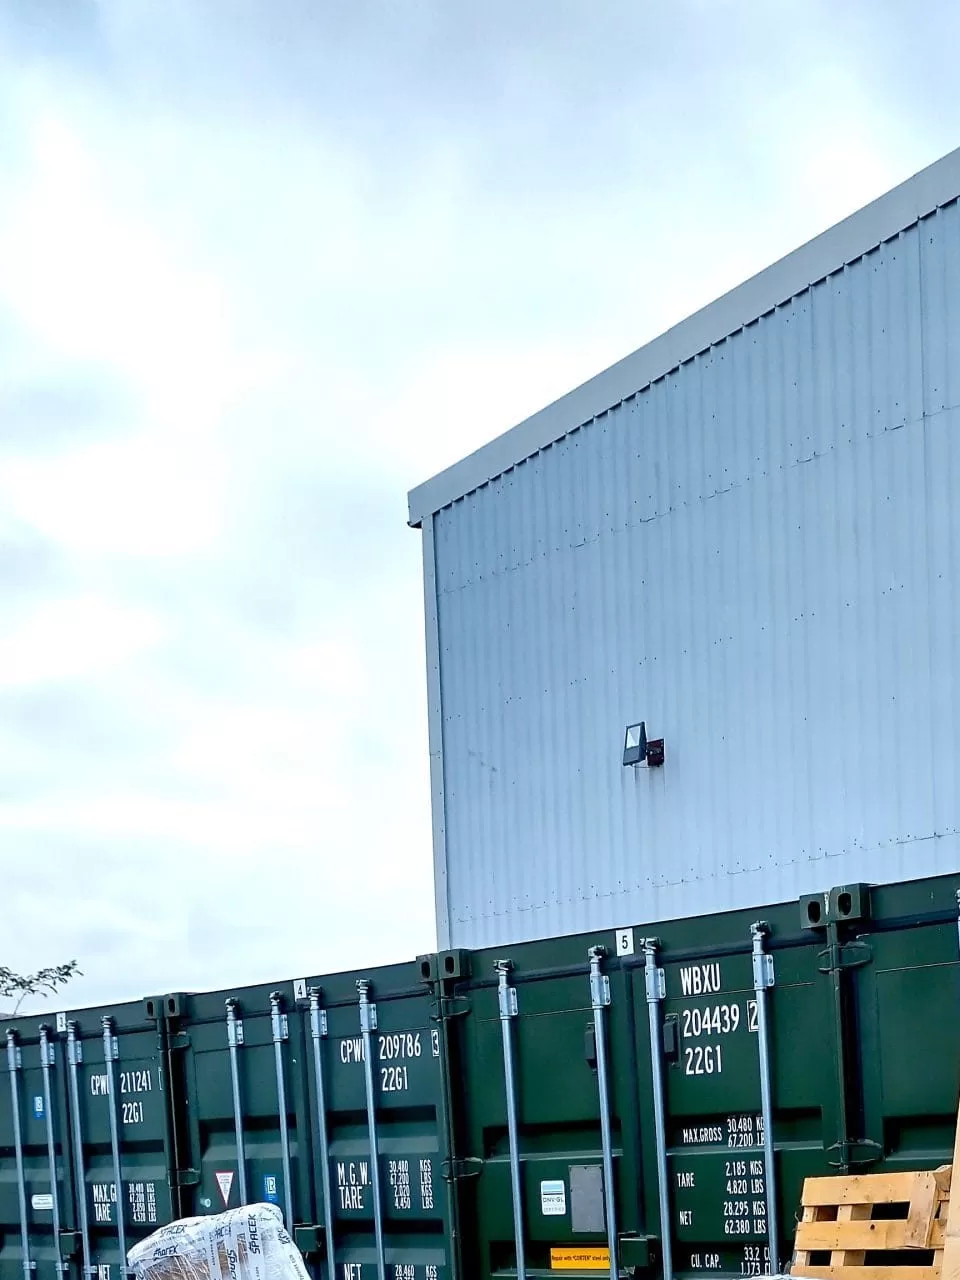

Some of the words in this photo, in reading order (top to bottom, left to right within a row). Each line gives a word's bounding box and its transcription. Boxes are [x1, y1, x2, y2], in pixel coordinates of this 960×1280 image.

[622, 935, 629, 950] 5
[680, 963, 721, 996] WBXU
[682, 1003, 740, 1038] 204439
[378, 1033, 421, 1060] 209786
[685, 1045, 722, 1075] 22G1
[120, 1070, 151, 1094] 211241
[381, 1066, 408, 1092] 22G1
[122, 1102, 144, 1124] 22G1
[682, 1127, 723, 1144] MAX.GROSS
[726, 1117, 753, 1133] 30.480
[727, 1132, 754, 1148] 67.200
[419, 1159, 432, 1172] KGS
[677, 1172, 695, 1187] TARE
[725, 1161, 746, 1176] 2.185
[750, 1160, 763, 1175] KGS
[420, 1172, 432, 1185] LBS
[726, 1180, 748, 1194] 4.820
[751, 1179, 764, 1194] LBS
[339, 1186, 365, 1209] TARE
[421, 1184, 433, 1197] KGS
[422, 1197, 434, 1209] LBS
[94, 1203, 112, 1222] TARE
[679, 1210, 693, 1226] NET
[723, 1201, 749, 1216] 28.295
[753, 1201, 766, 1216] KGS
[247, 1214, 260, 1254] SPACEK
[724, 1219, 750, 1234] 62.380
[753, 1219, 767, 1234] LBS
[691, 1254, 703, 1268] CU.
[705, 1254, 722, 1269] CAP.
[743, 1246, 760, 1261] 33.2
[740, 1261, 761, 1276] 1.173
[425, 1265, 437, 1277] KGS
